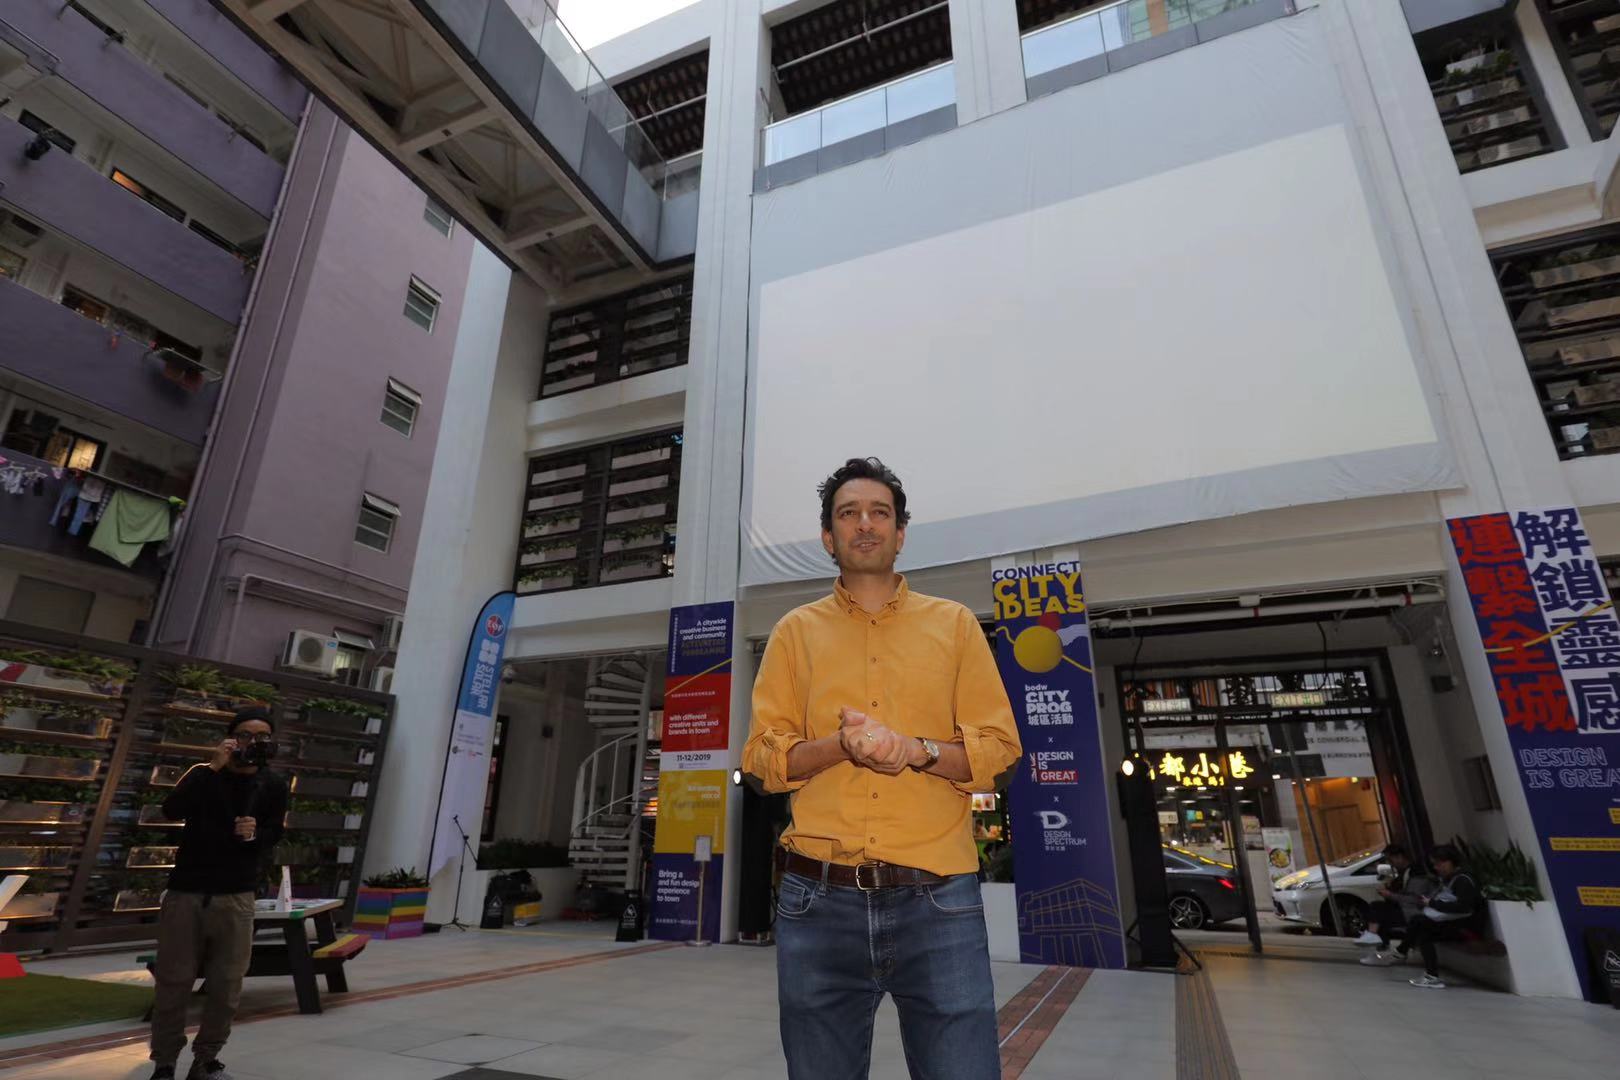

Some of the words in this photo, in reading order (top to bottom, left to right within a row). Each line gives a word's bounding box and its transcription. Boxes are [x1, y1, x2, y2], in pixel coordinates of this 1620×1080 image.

[992, 561, 1080, 581] CONNECT
[994, 572, 1081, 602] CITY
[702, 618, 727, 627] citywide
[702, 625, 727, 633] business
[682, 633, 694, 641] and
[694, 631, 727, 640] community
[470, 663, 486, 695] SOLAR
[477, 666, 495, 709] STELLAR
[1026, 690, 1070, 703] CITY
[1274, 693, 1300, 707] EXIT
[1026, 701, 1072, 714] PROG
[682, 713, 707, 721] different
[1028, 713, 1074, 725] 城區活動
[707, 719, 719, 727] and
[668, 728, 688, 736] brands
[676, 753, 711, 761] 11-12/2019
[1037, 751, 1074, 761] DESIGN
[1520, 747, 1608, 767] DESIGN
[1038, 761, 1048, 770] IS
[1040, 771, 1076, 781] GREAT
[1526, 769, 1554, 788] IS
[1560, 767, 1620, 788] GREA
[1045, 838, 1087, 846] SPECTRUM
[659, 870, 678, 880] Bring
[657, 887, 690, 895] experience
